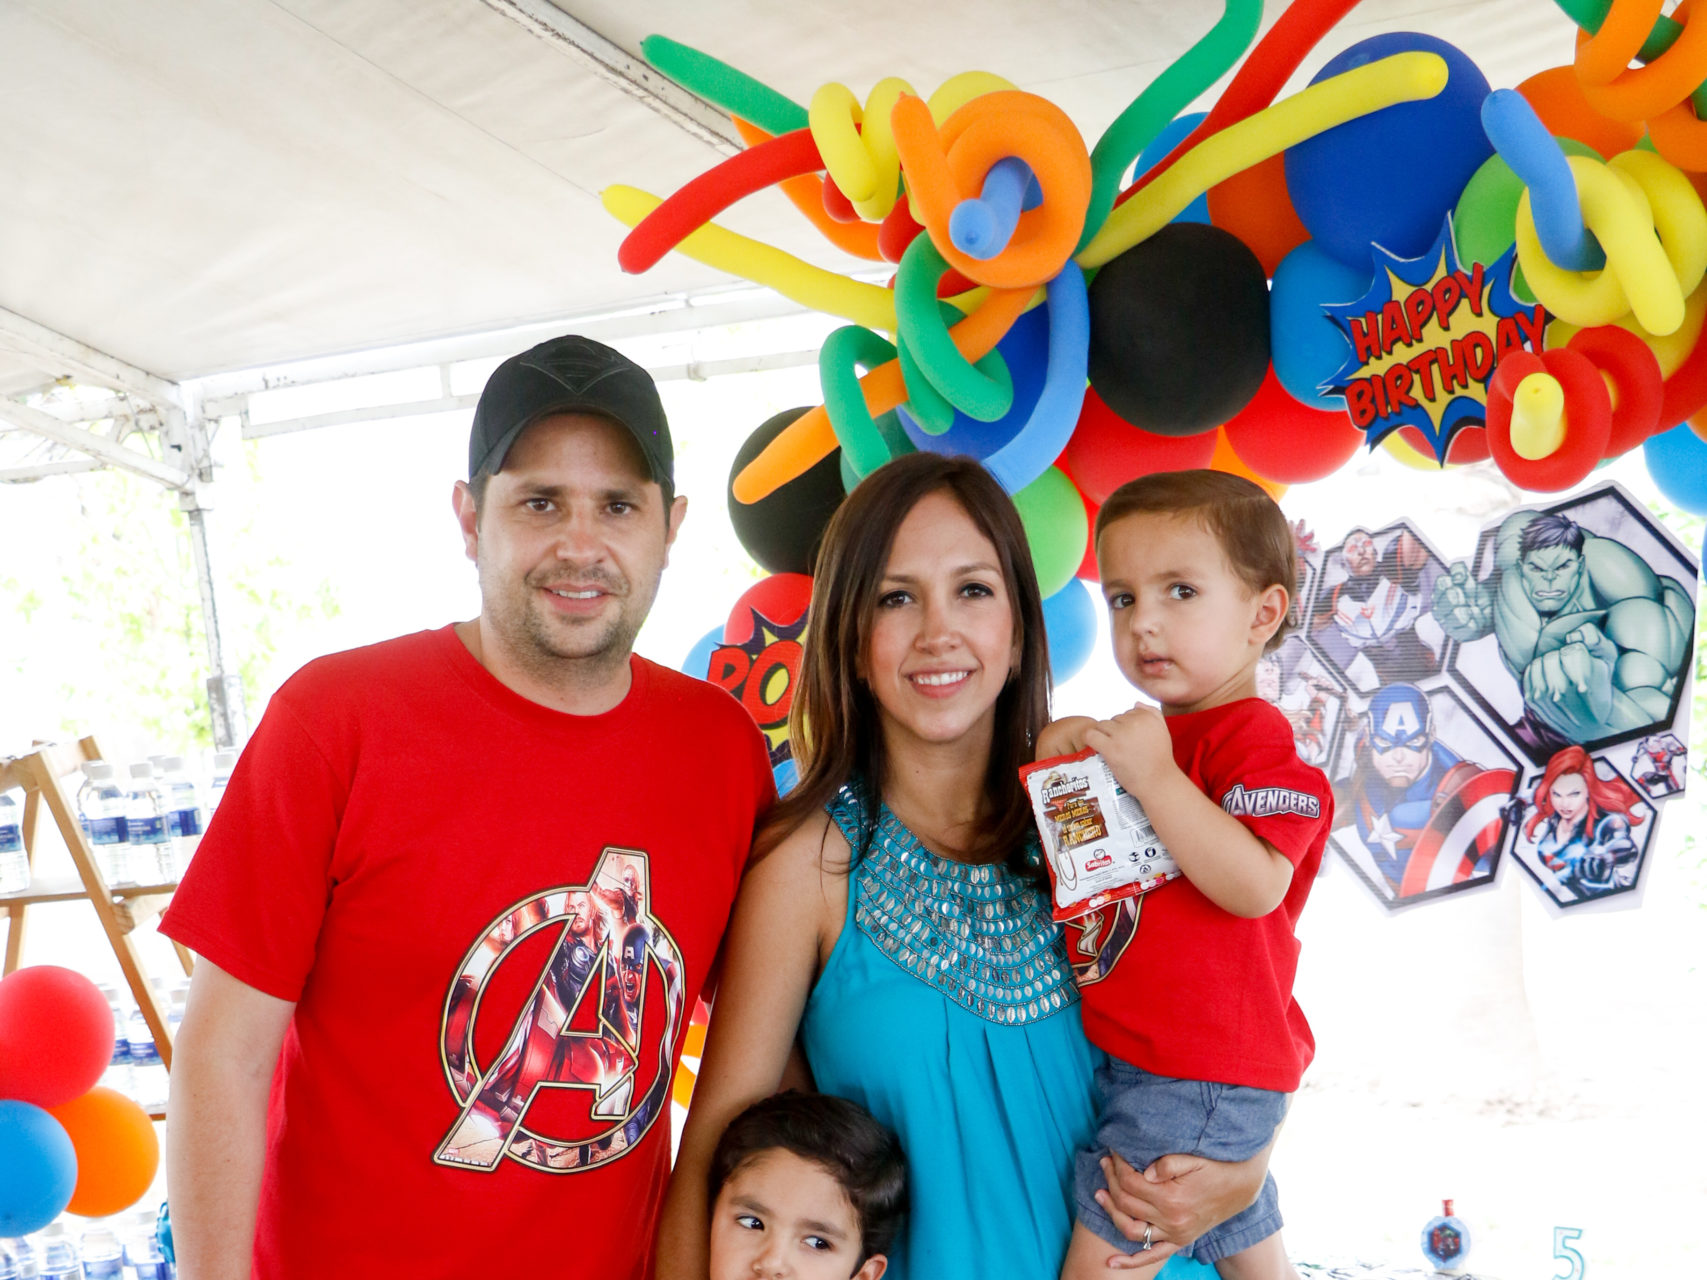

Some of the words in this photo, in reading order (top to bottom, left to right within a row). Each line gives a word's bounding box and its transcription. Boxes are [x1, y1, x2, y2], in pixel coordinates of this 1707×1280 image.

[1351, 262, 1484, 363] HAPPY
[1344, 304, 1546, 430] BIRTHDAY
[1041, 776, 1090, 806] Rancheritos
